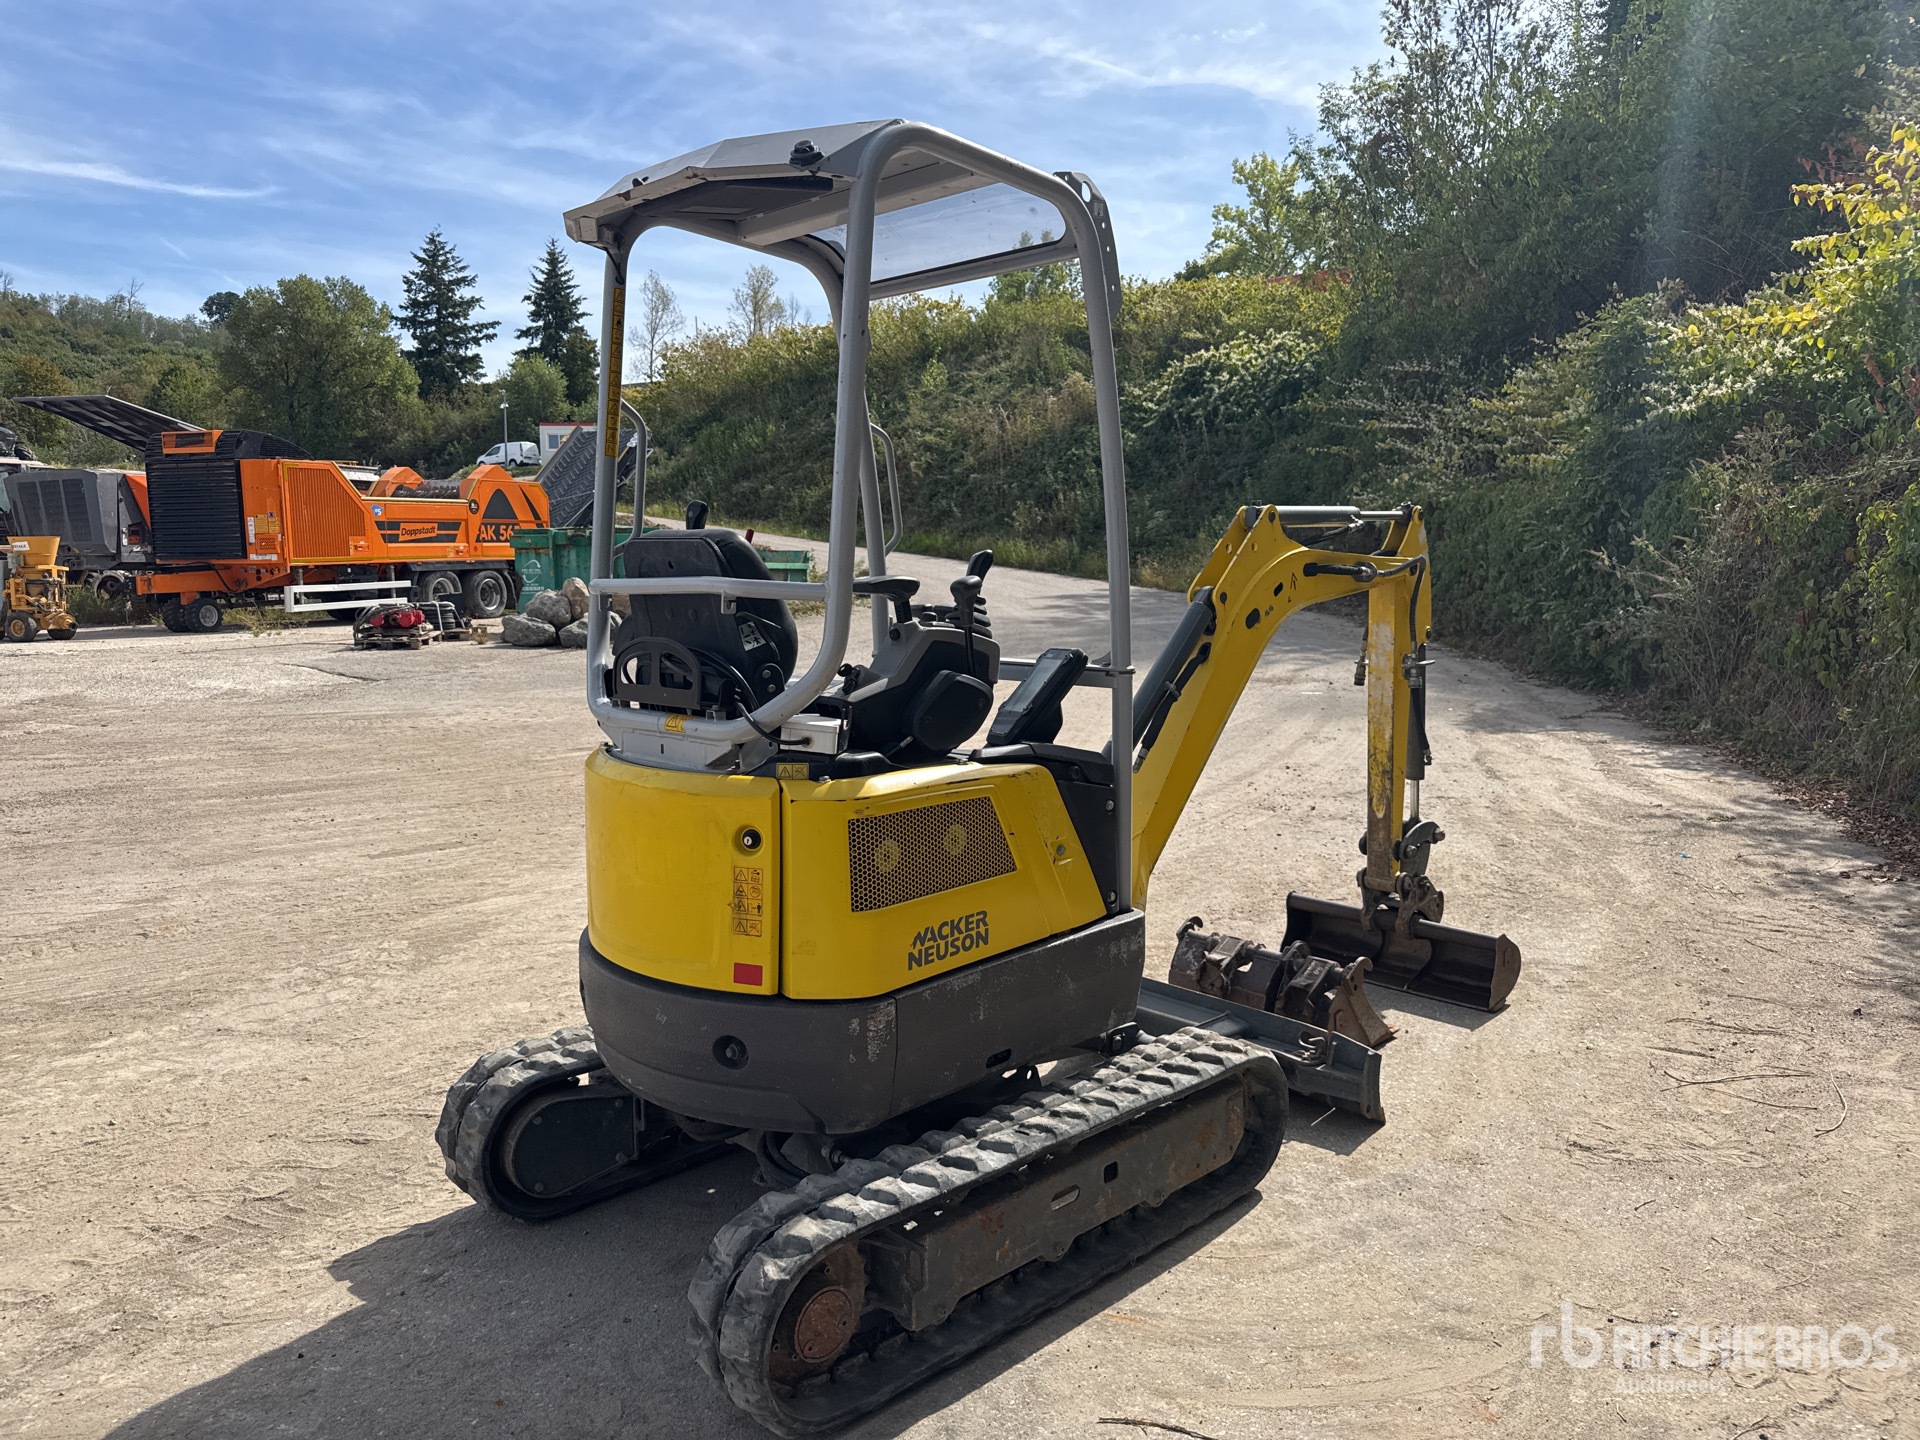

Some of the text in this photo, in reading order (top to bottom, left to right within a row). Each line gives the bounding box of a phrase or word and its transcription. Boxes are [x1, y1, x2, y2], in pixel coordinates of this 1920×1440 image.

[401, 525, 436, 537] Doppstadt
[479, 524, 497, 541] AK
[912, 910, 989, 950] WACKER
[908, 927, 989, 971] NEUSON
